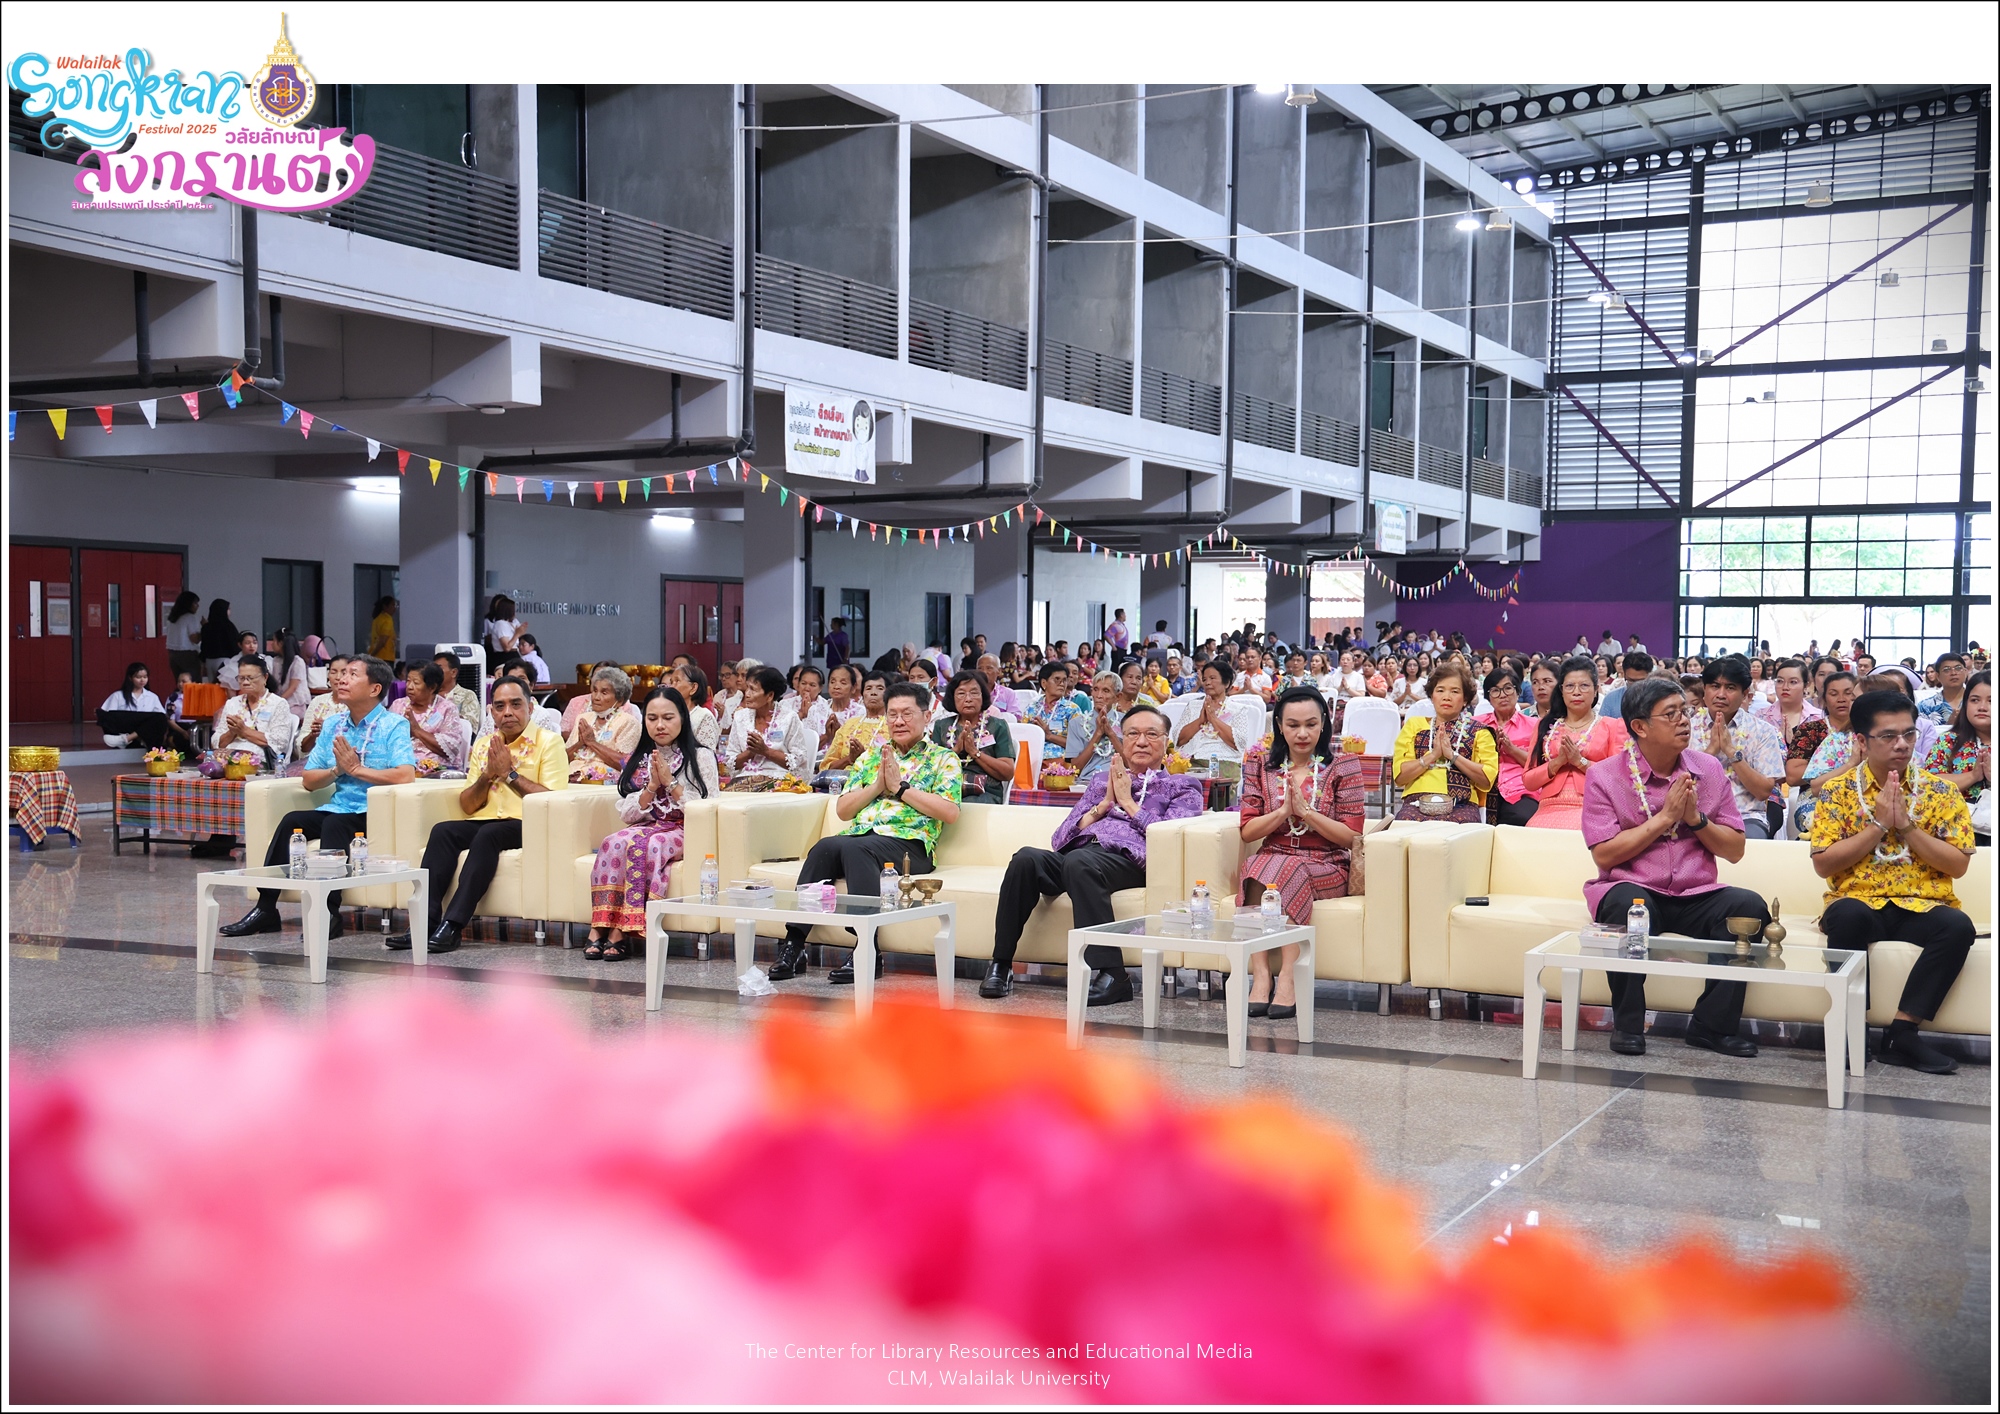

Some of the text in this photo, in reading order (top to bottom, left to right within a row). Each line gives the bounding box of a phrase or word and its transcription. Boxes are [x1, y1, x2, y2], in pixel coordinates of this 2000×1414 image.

[514, 602, 621, 617] CHITECTURE AND DESIGN
